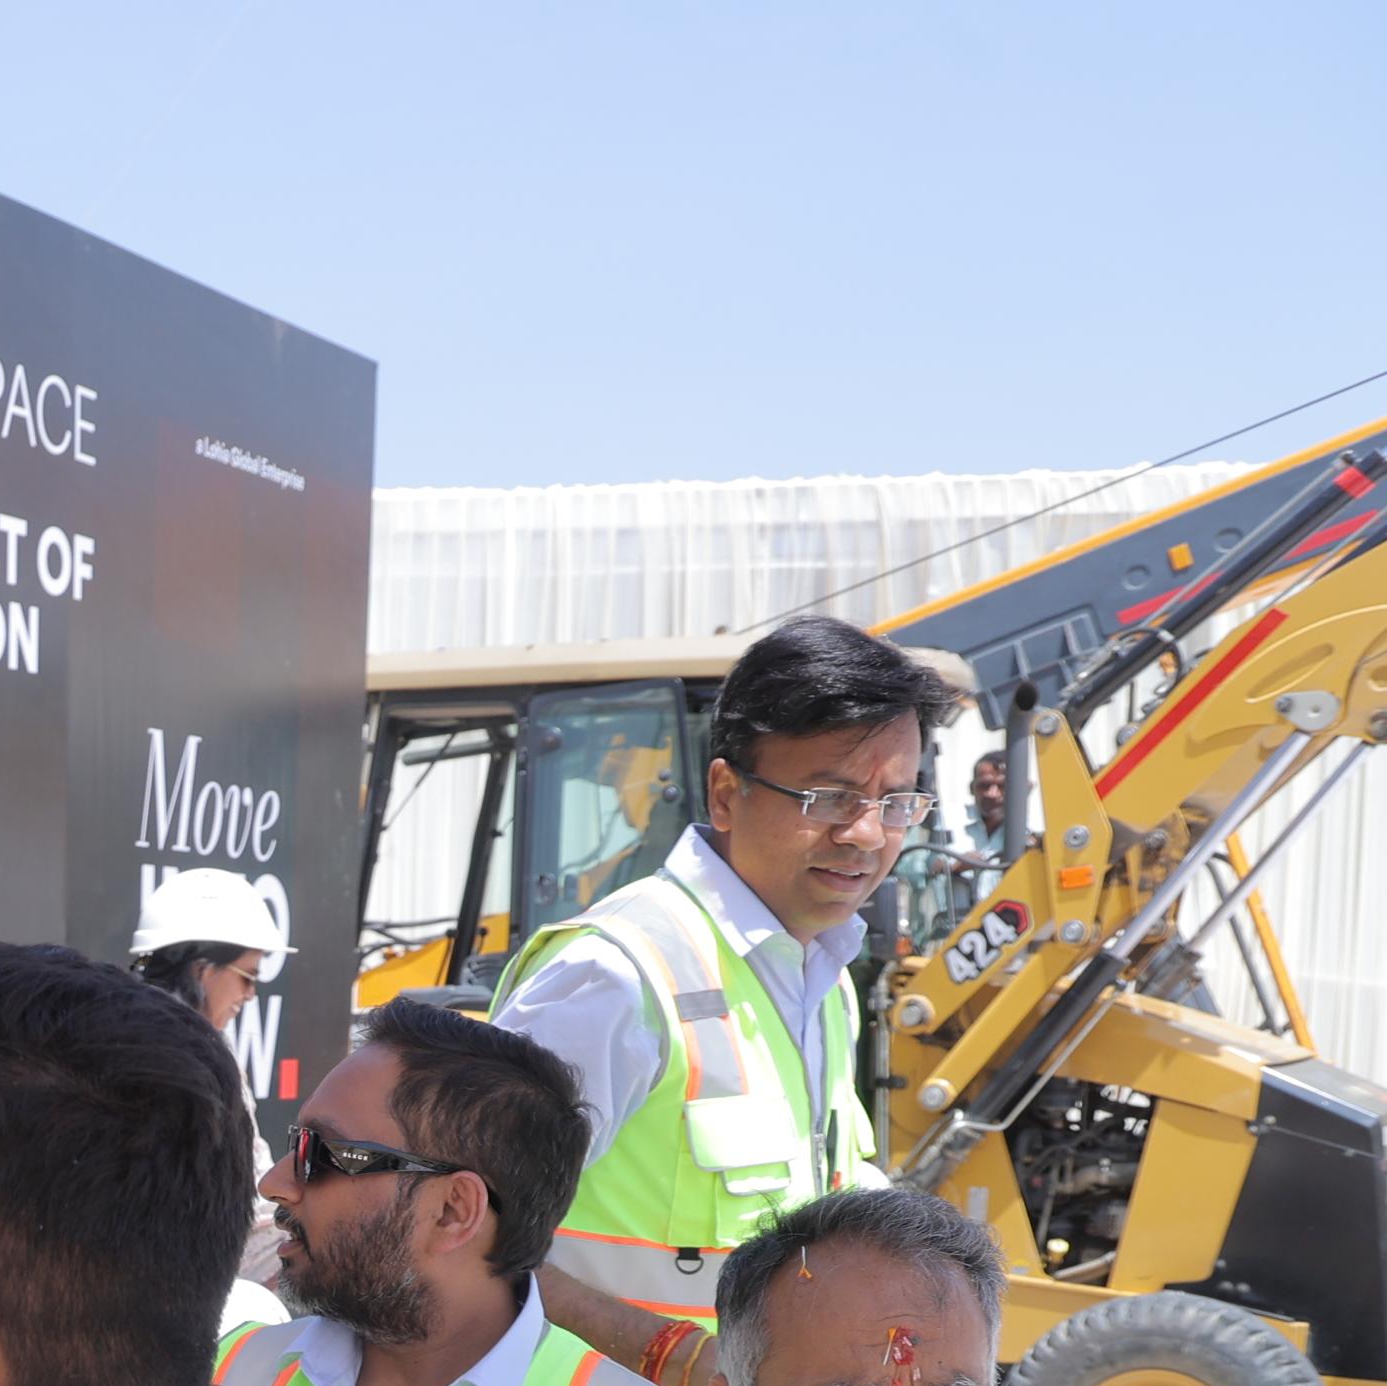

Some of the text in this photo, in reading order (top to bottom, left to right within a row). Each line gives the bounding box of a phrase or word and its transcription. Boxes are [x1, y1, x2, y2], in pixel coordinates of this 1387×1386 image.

[36, 525, 95, 601] OF
[135, 727, 280, 863] Move
[944, 911, 1018, 984] 424
